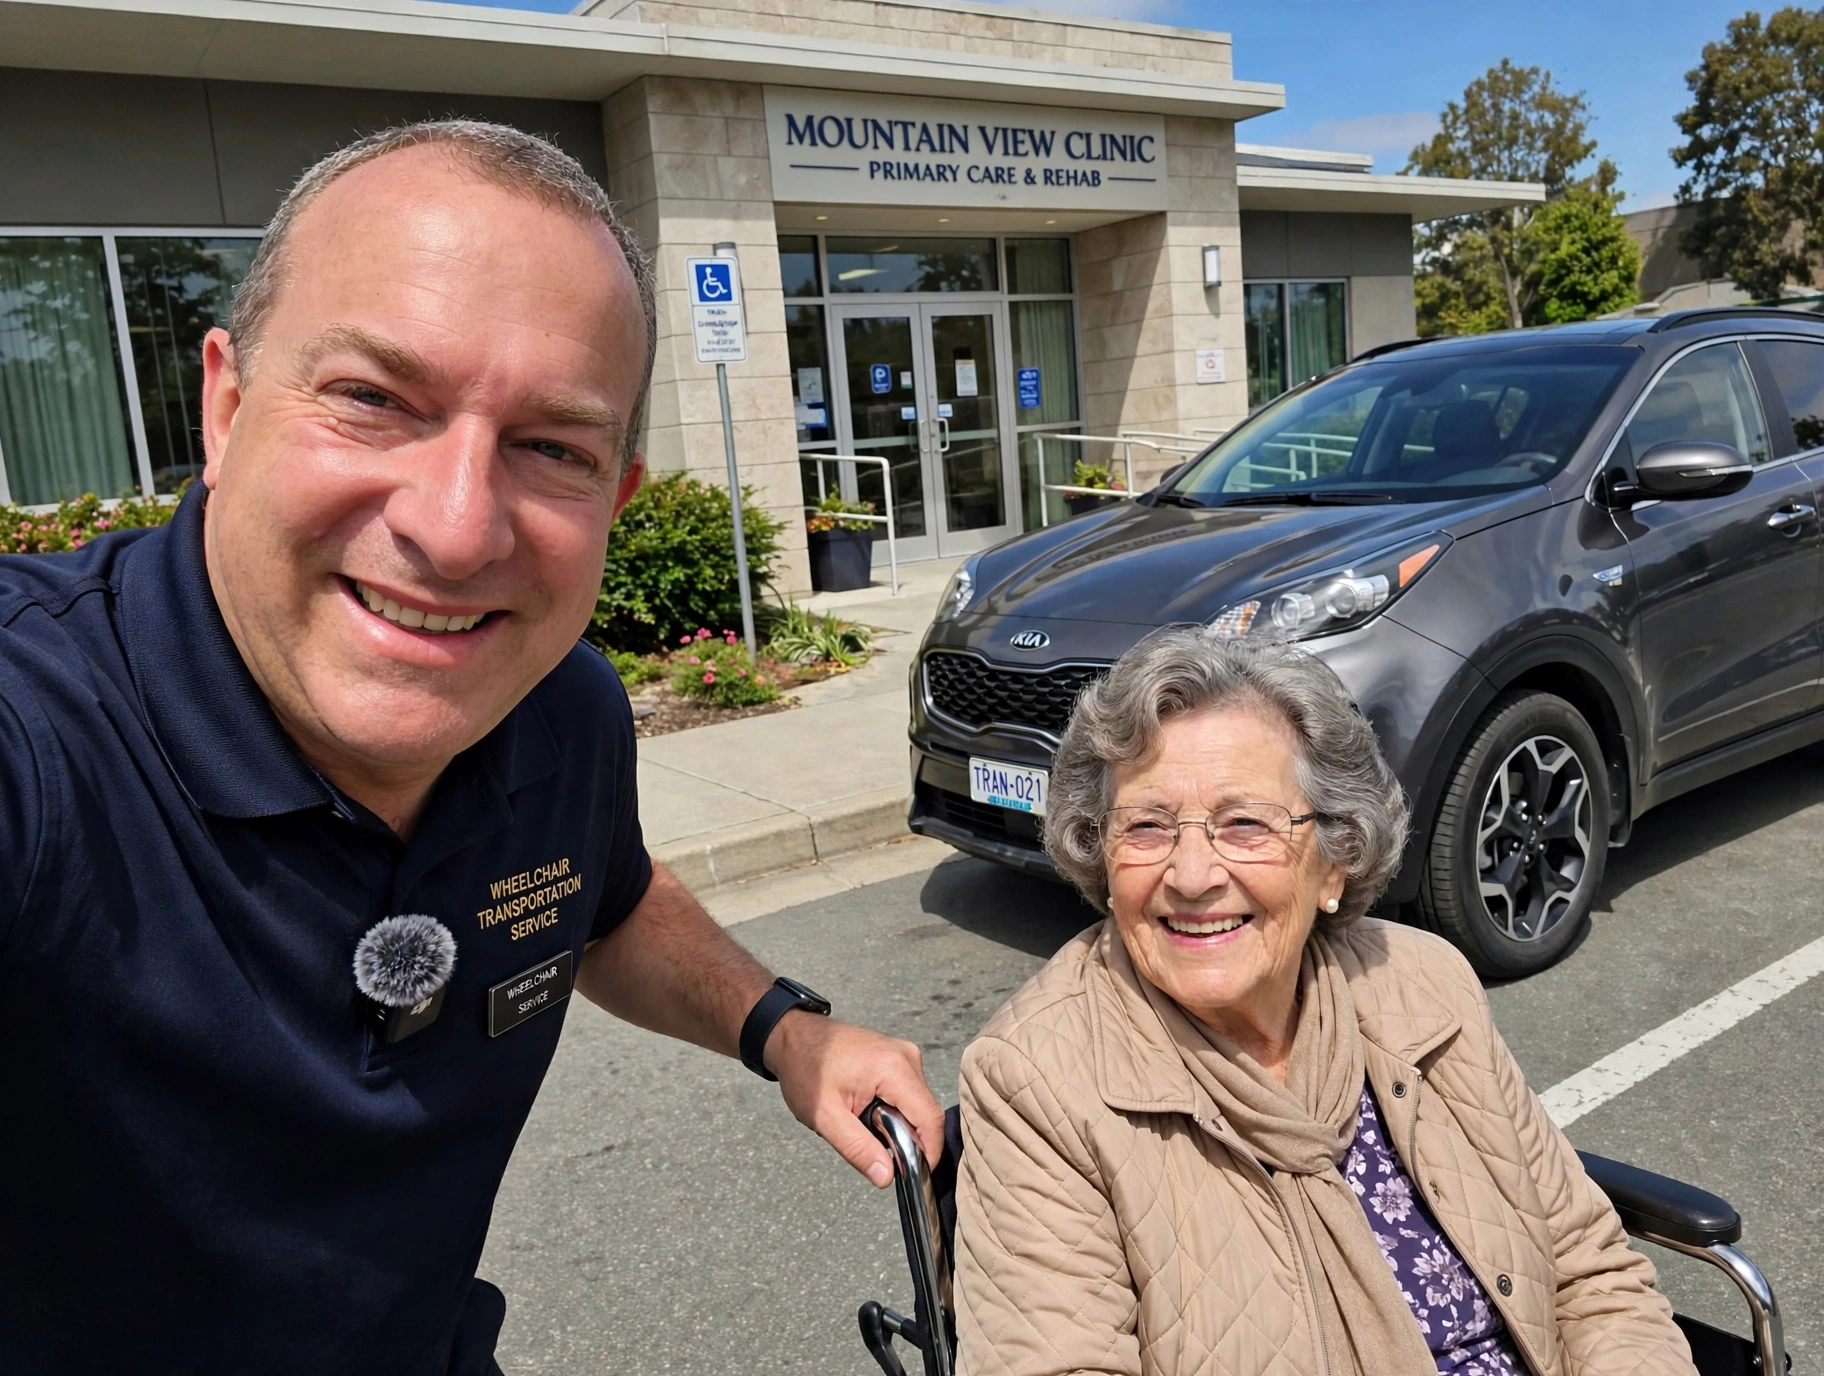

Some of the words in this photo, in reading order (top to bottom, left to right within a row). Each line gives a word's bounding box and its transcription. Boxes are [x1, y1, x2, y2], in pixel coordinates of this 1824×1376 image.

[785, 113, 969, 154] MOUNTAIN
[977, 125, 1056, 158] VIEW
[1065, 131, 1156, 163] CLINIC
[869, 161, 960, 182] PRIMARY
[967, 165, 1018, 185] CARE
[1024, 169, 1037, 185] &
[1044, 169, 1102, 187] REHAB
[1013, 632, 1042, 647] KIA
[973, 766, 1042, 803] TRAN-021
[490, 857, 570, 900] WHEELCHAIR
[477, 873, 582, 930] TRANSPORTATION
[510, 907, 559, 941] SERVICE
[518, 990, 549, 1014] SERVICE
